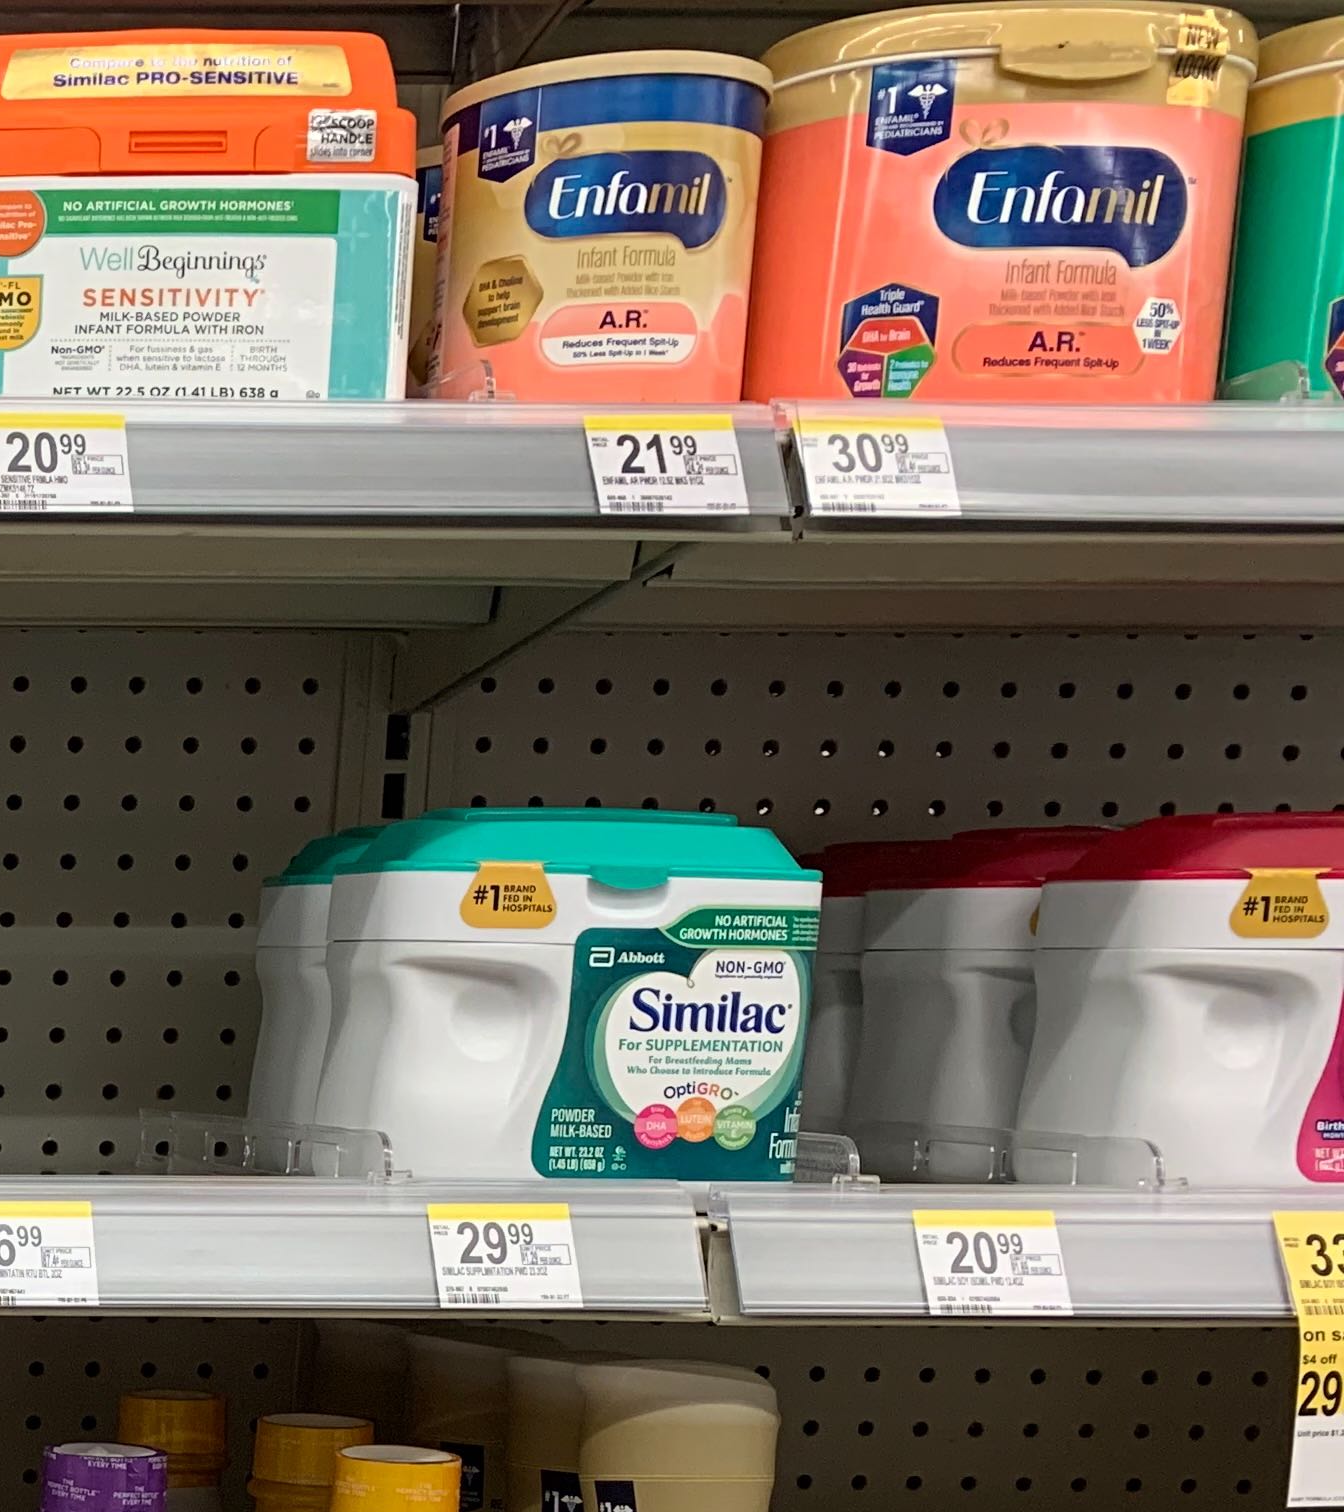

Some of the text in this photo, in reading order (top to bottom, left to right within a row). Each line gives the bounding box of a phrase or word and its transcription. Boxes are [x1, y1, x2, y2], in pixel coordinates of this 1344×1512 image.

[53, 71, 299, 87] Similac PRO-SENSITIVE
[321, 133, 374, 145] HANDLE
[548, 171, 708, 222] Enfamil
[968, 169, 1160, 226] Enfamil
[83, 288, 260, 307] SENSITIVITY
[599, 308, 645, 330] A.R.
[983, 355, 1035, 369] Reduces
[1038, 356, 1080, 371] Frequent
[716, 960, 785, 975] NON-GMO
[629, 989, 785, 1035] Similac
[618, 1039, 783, 1053] For SUPPLEMENTATION
